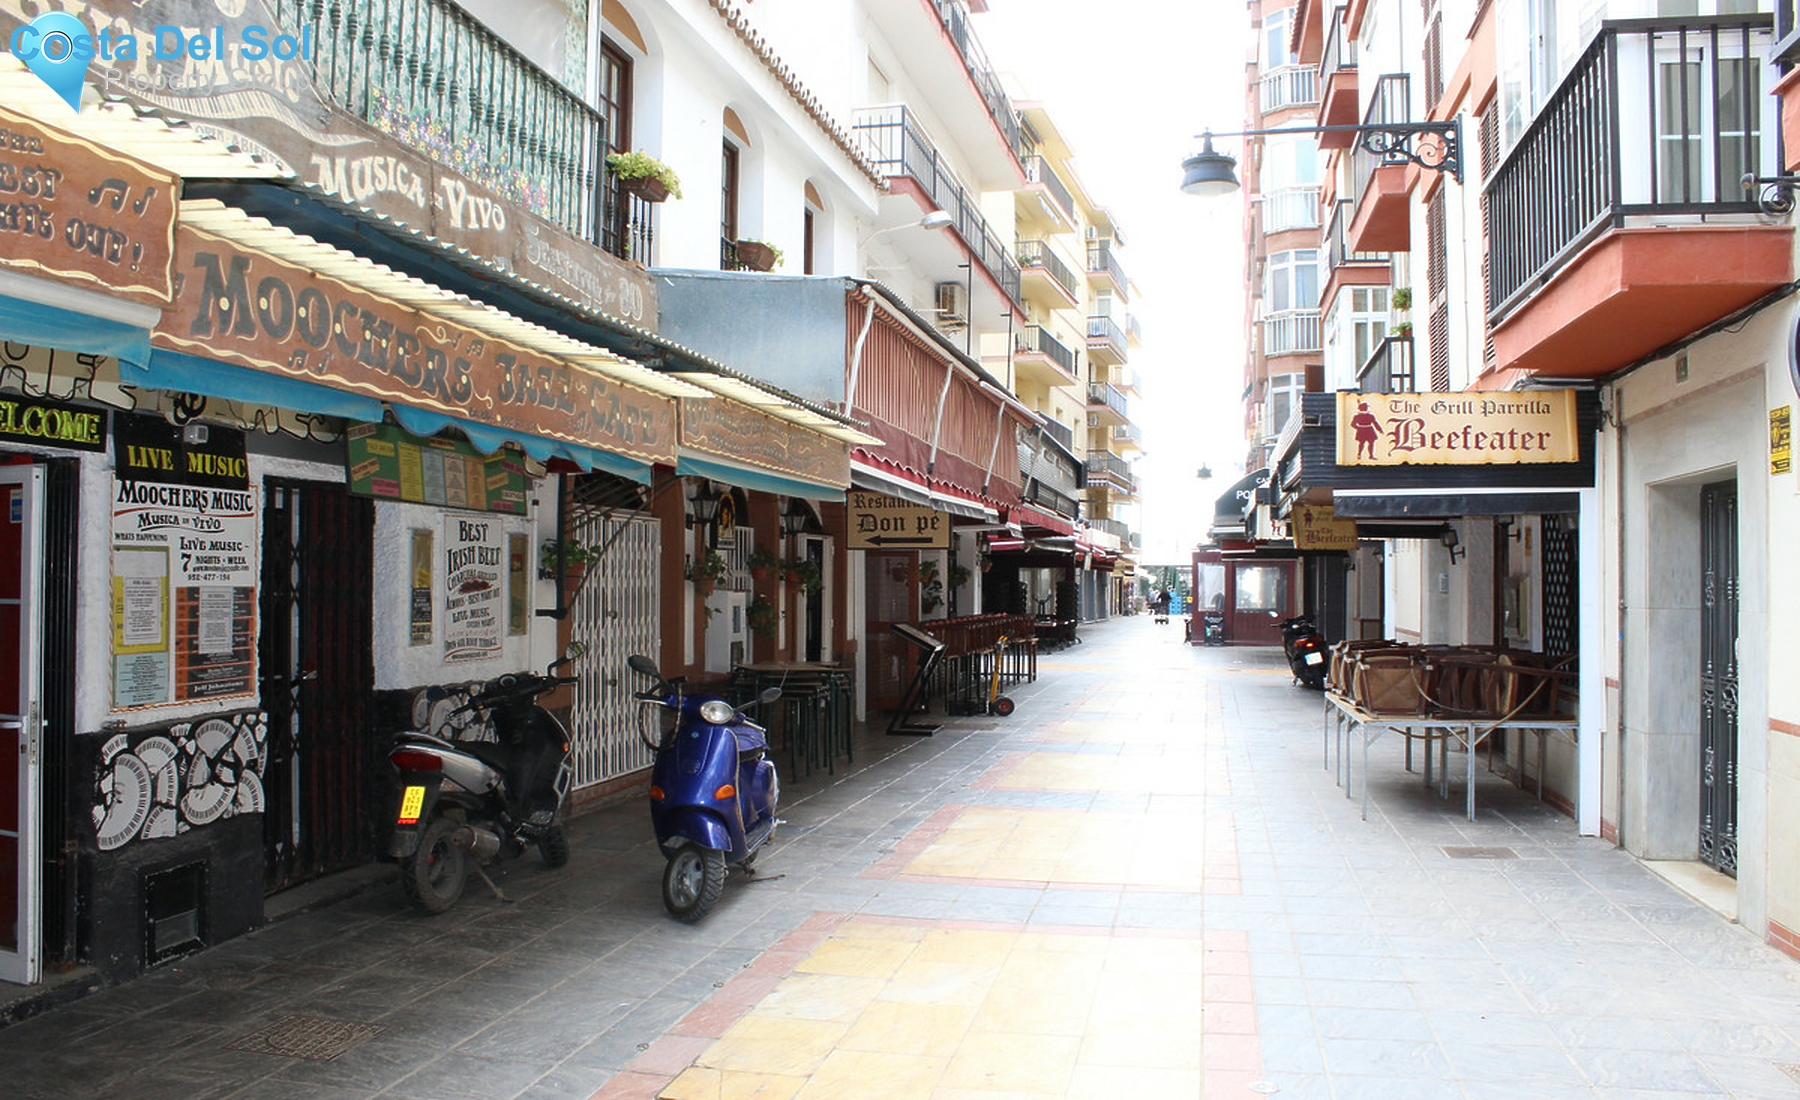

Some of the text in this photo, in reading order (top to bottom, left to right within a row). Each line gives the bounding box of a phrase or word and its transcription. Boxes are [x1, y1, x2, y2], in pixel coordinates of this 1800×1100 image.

[311, 152, 425, 209] MUSICA
[440, 176, 506, 231] VIVO
[190, 252, 475, 403] MOOCHERS
[495, 353, 576, 415] JAZZ
[1389, 400, 1551, 417] The Grill Parrilla
[1386, 417, 1551, 457] Beefeater
[127, 445, 247, 478] LIVE MUSIC
[117, 480, 254, 513] MOOCHERS MUSIC
[138, 512, 180, 528] MUSICA
[192, 516, 222, 530] VIVO
[459, 520, 489, 542] BEST
[856, 510, 940, 535] Don pé
[180, 536, 243, 552] LIVE MUSIC
[180, 553, 191, 572] 7
[447, 548, 476, 576] IRISH
